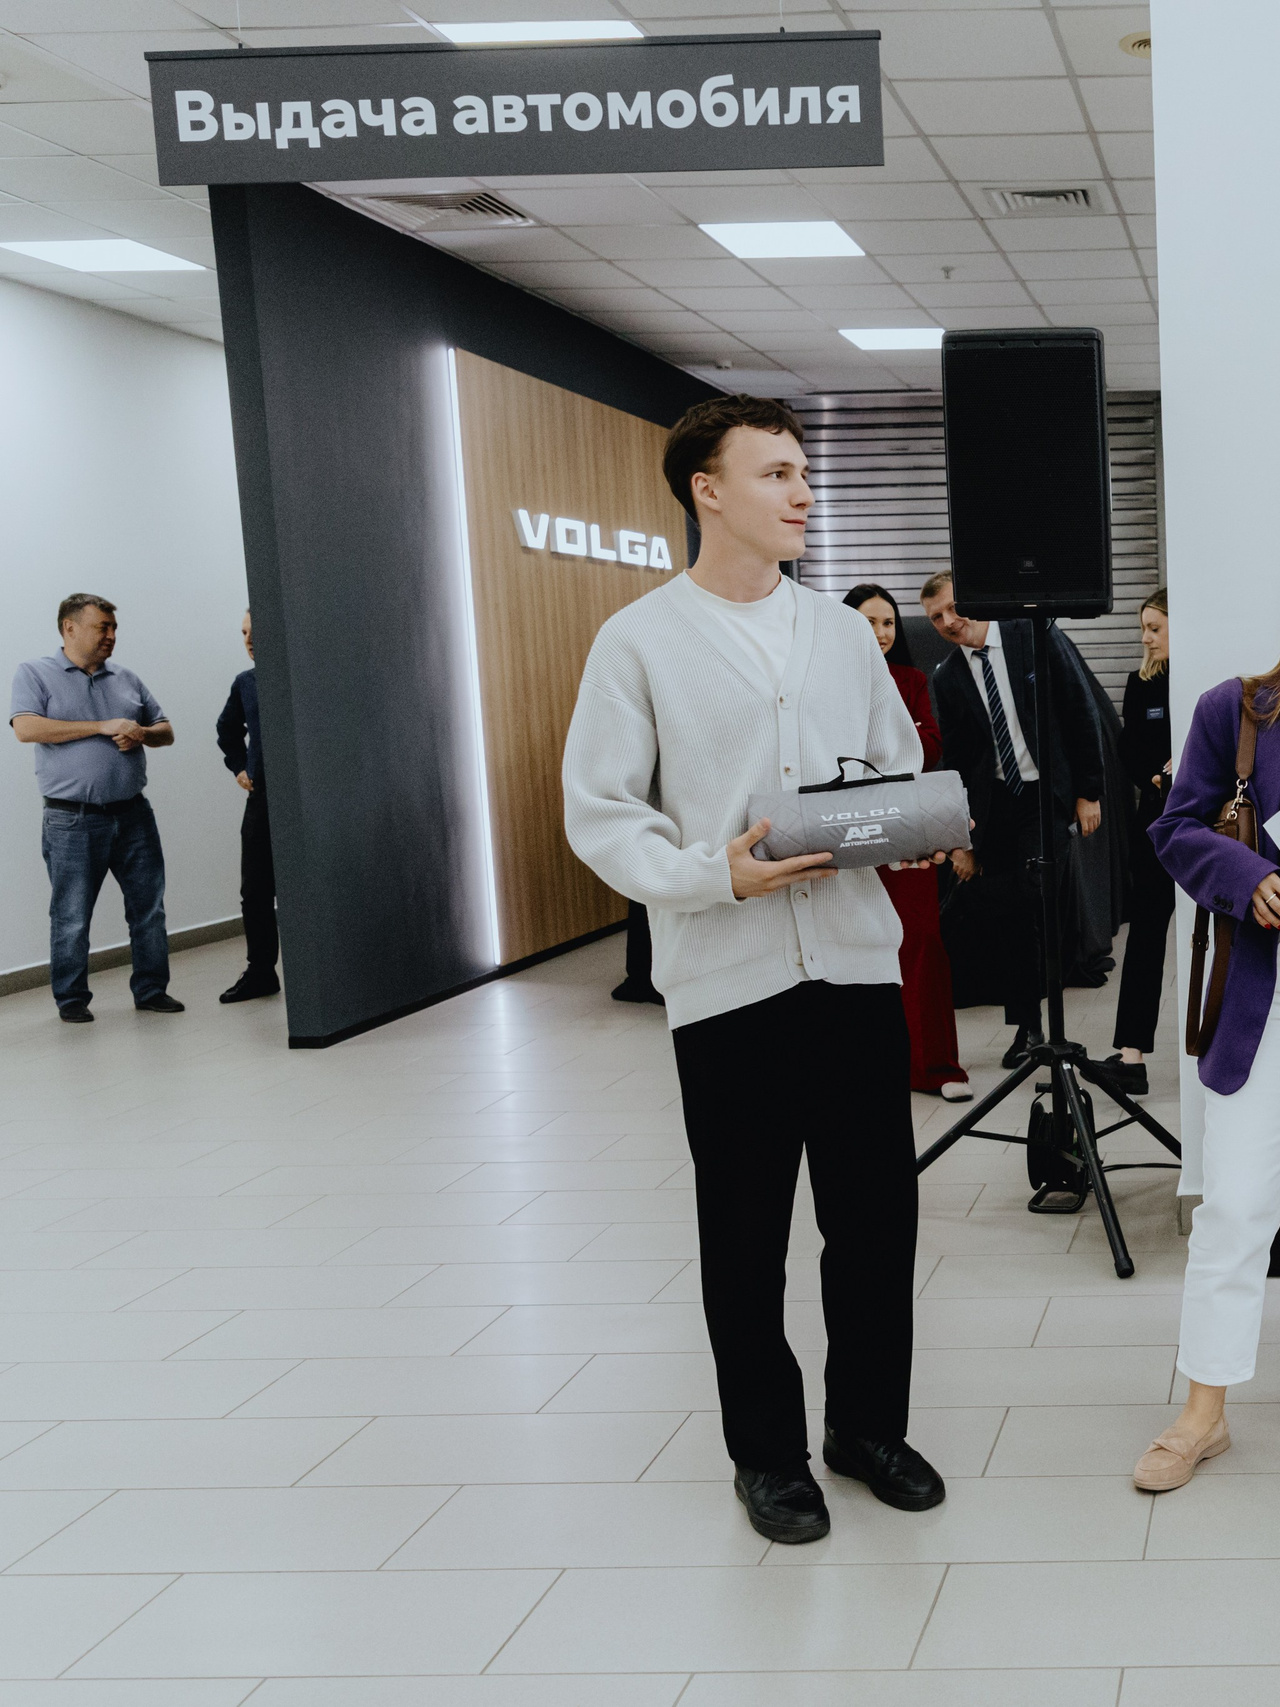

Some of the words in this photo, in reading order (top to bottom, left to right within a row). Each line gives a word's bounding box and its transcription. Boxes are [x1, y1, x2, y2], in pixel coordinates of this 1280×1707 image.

[173, 87, 438, 150] Выдача
[452, 73, 863, 135] автомобиля
[515, 508, 673, 571] VOLGA
[820, 807, 901, 822] VOLGA
